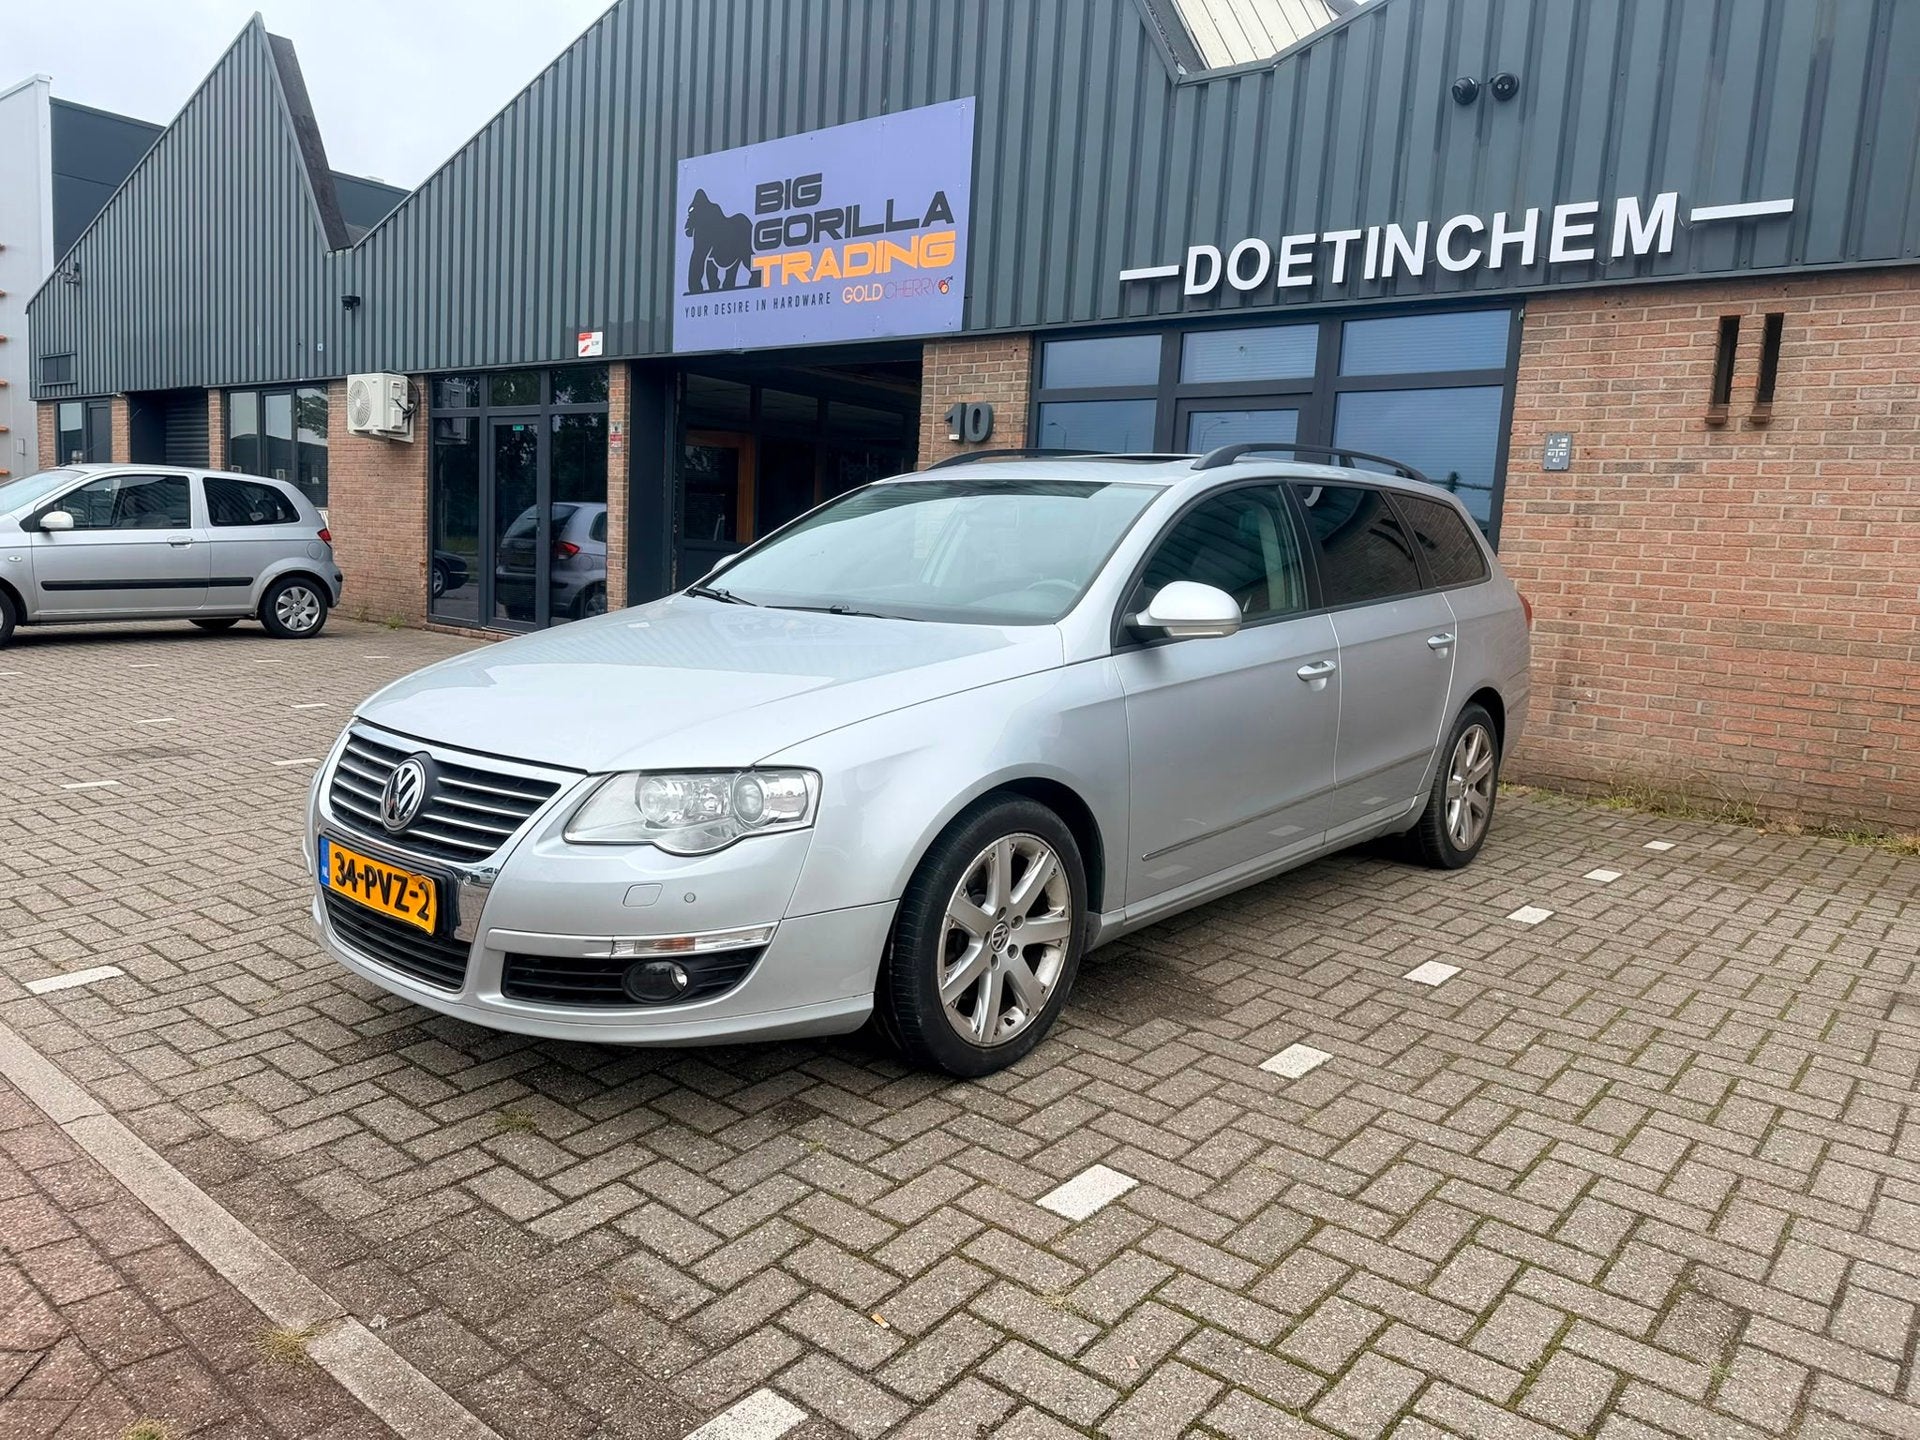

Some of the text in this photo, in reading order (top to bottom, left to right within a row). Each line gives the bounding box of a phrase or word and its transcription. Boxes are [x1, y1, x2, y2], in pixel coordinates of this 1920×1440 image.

[753, 190, 955, 251] GORILLA
[755, 172, 823, 215] BIG
[752, 230, 956, 288] TRADING
[1183, 191, 1679, 295] DOETINCHEM
[684, 291, 831, 318] YOUR DESIRE IN HARDWARE
[944, 402, 993, 443] 10
[334, 851, 430, 921] 34-PVZ-2
